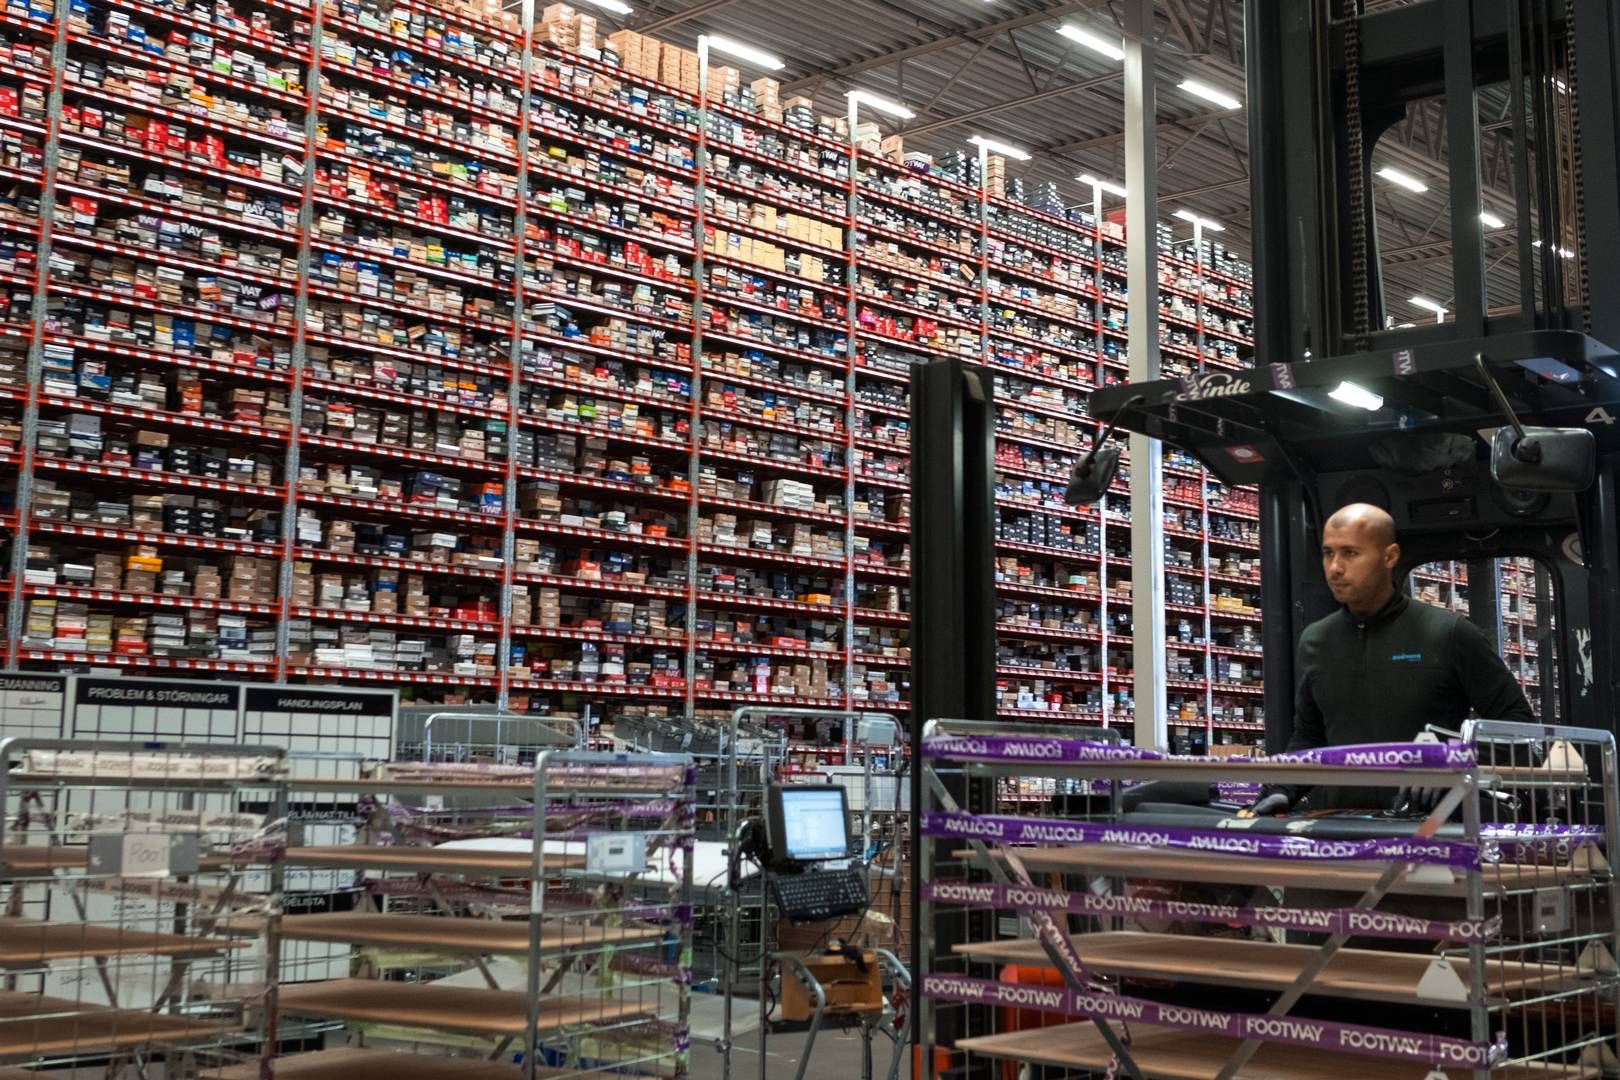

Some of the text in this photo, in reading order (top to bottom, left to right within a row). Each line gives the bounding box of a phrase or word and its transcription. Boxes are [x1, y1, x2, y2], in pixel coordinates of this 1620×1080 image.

[88, 688, 230, 704] PROBLEM & STÖRNINGAR
[278, 698, 364, 711] HANDLINGSPLAN
[1003, 743, 1063, 759] FOOTWAY
[1345, 750, 1423, 766] FOOTWAY
[944, 819, 1004, 837] FOOTWAY
[1020, 824, 1084, 842] FOOTWAY
[1101, 830, 1169, 847] FOOTWAY
[1187, 836, 1259, 854] FOOTWAY
[933, 885, 994, 902] FOOTWAY
[1007, 889, 1071, 908] FOOTWAY
[1084, 897, 1152, 914] FOOTWAY
[1166, 901, 1239, 919] FOOTWAY
[1254, 908, 1332, 929] FOOTWAY
[1349, 913, 1430, 934] FOOTWAY
[924, 978, 985, 998] FOOTWAY
[998, 987, 1063, 1008] FOOTWAY
[1076, 995, 1144, 1019] FOOTWAY
[1159, 1008, 1231, 1030] FOOTWAY
[1247, 1018, 1324, 1043] FOOTWAY
[1340, 1030, 1422, 1055] FOOTWAY
